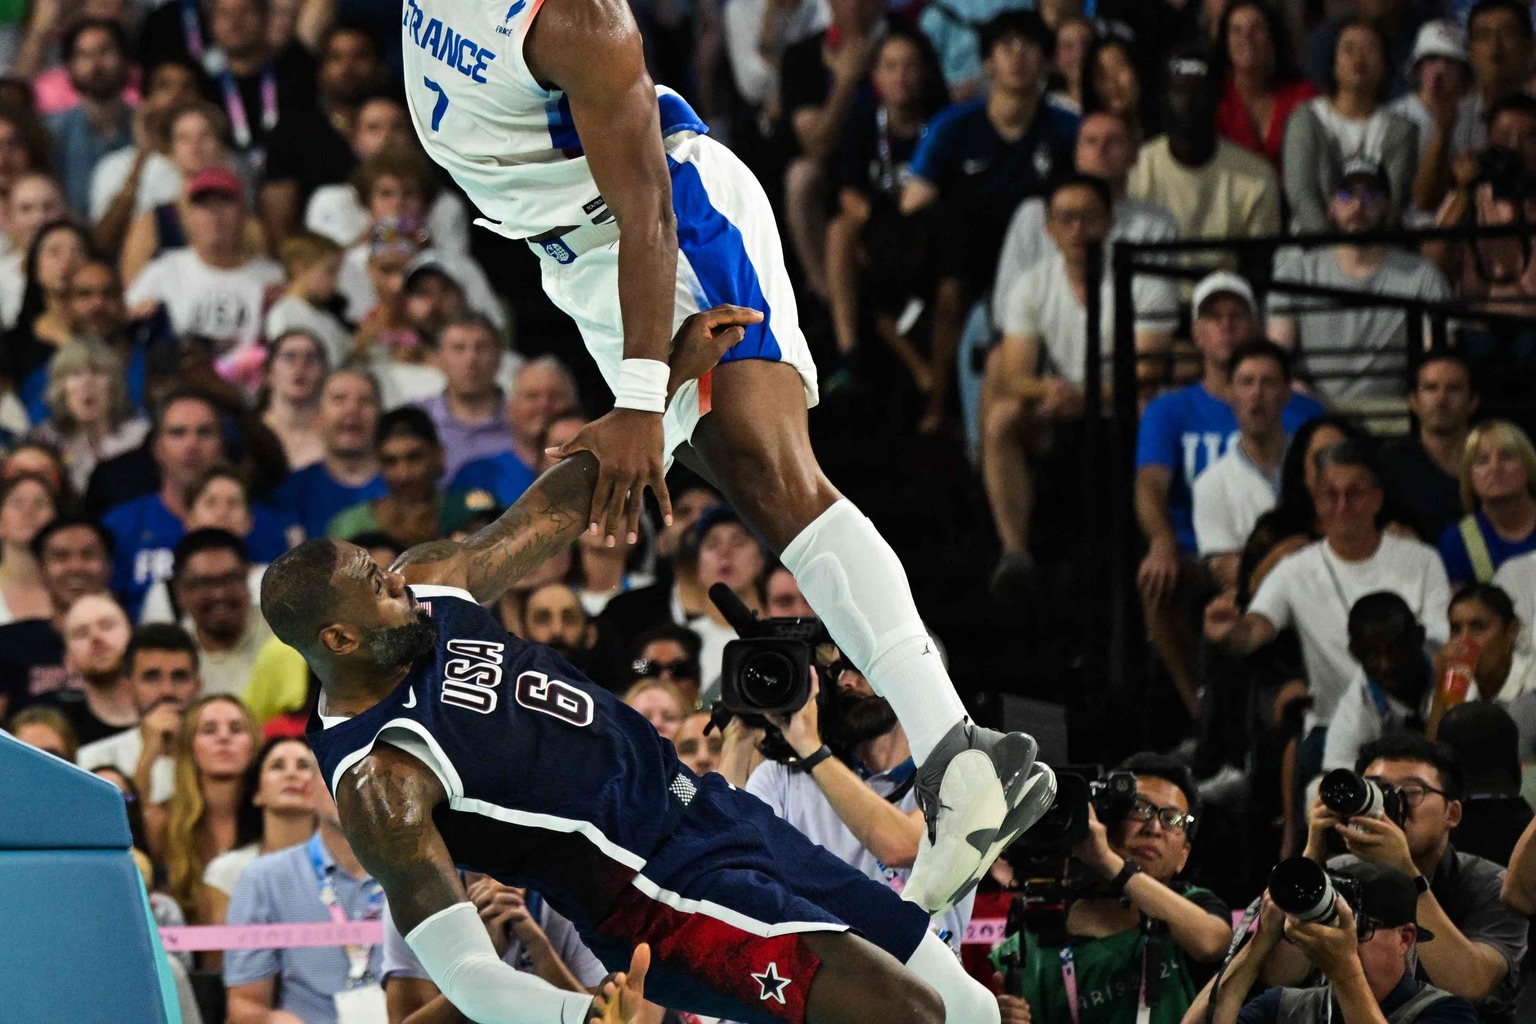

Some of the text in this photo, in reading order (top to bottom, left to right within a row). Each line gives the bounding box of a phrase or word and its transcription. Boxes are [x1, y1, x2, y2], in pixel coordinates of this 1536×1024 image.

[423, 75, 450, 133] 7
[440, 638, 506, 715] USA
[515, 670, 595, 727] 6
